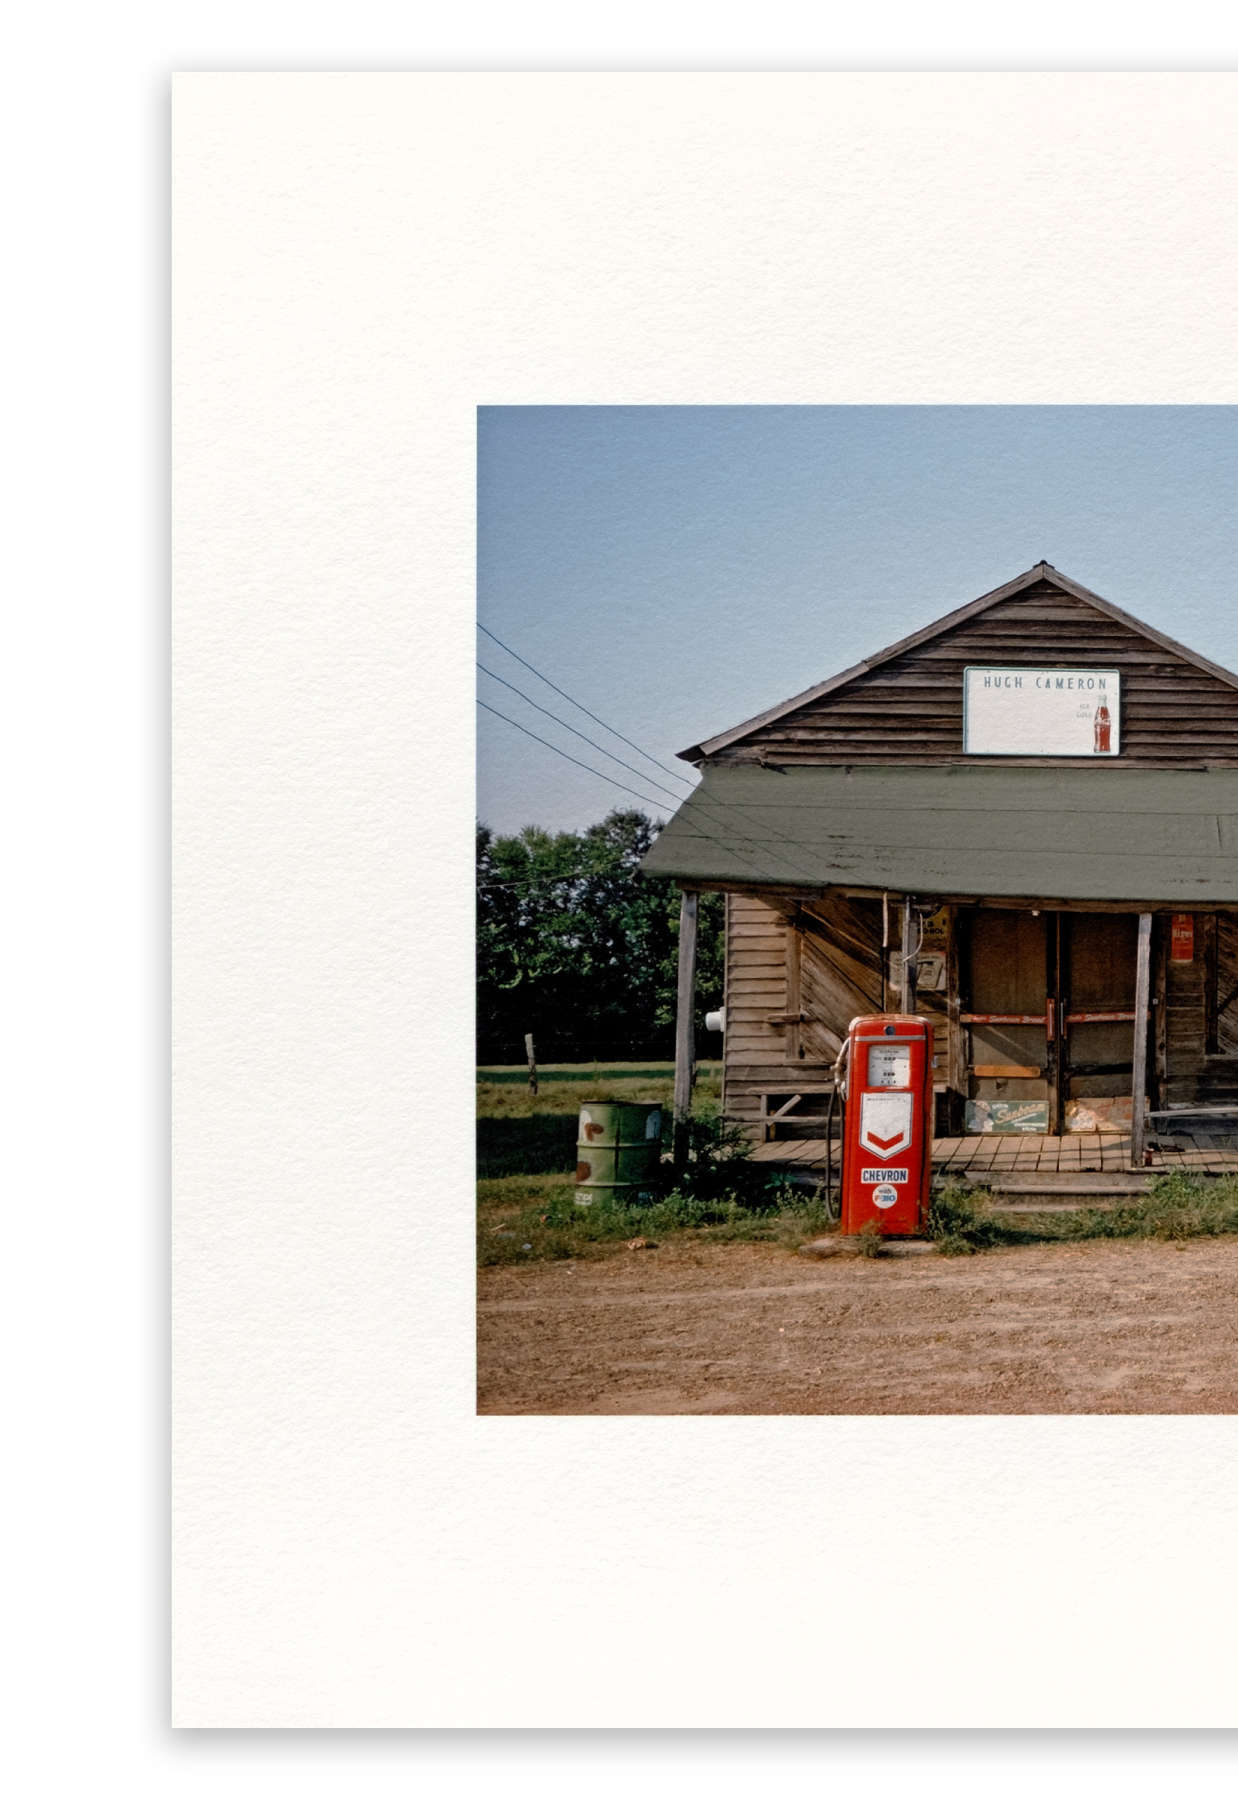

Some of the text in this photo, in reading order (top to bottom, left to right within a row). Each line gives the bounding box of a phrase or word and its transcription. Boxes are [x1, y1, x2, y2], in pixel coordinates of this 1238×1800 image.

[984, 676, 1107, 689] HUGH CAMERON
[862, 1170, 907, 1181] CHEVRON
